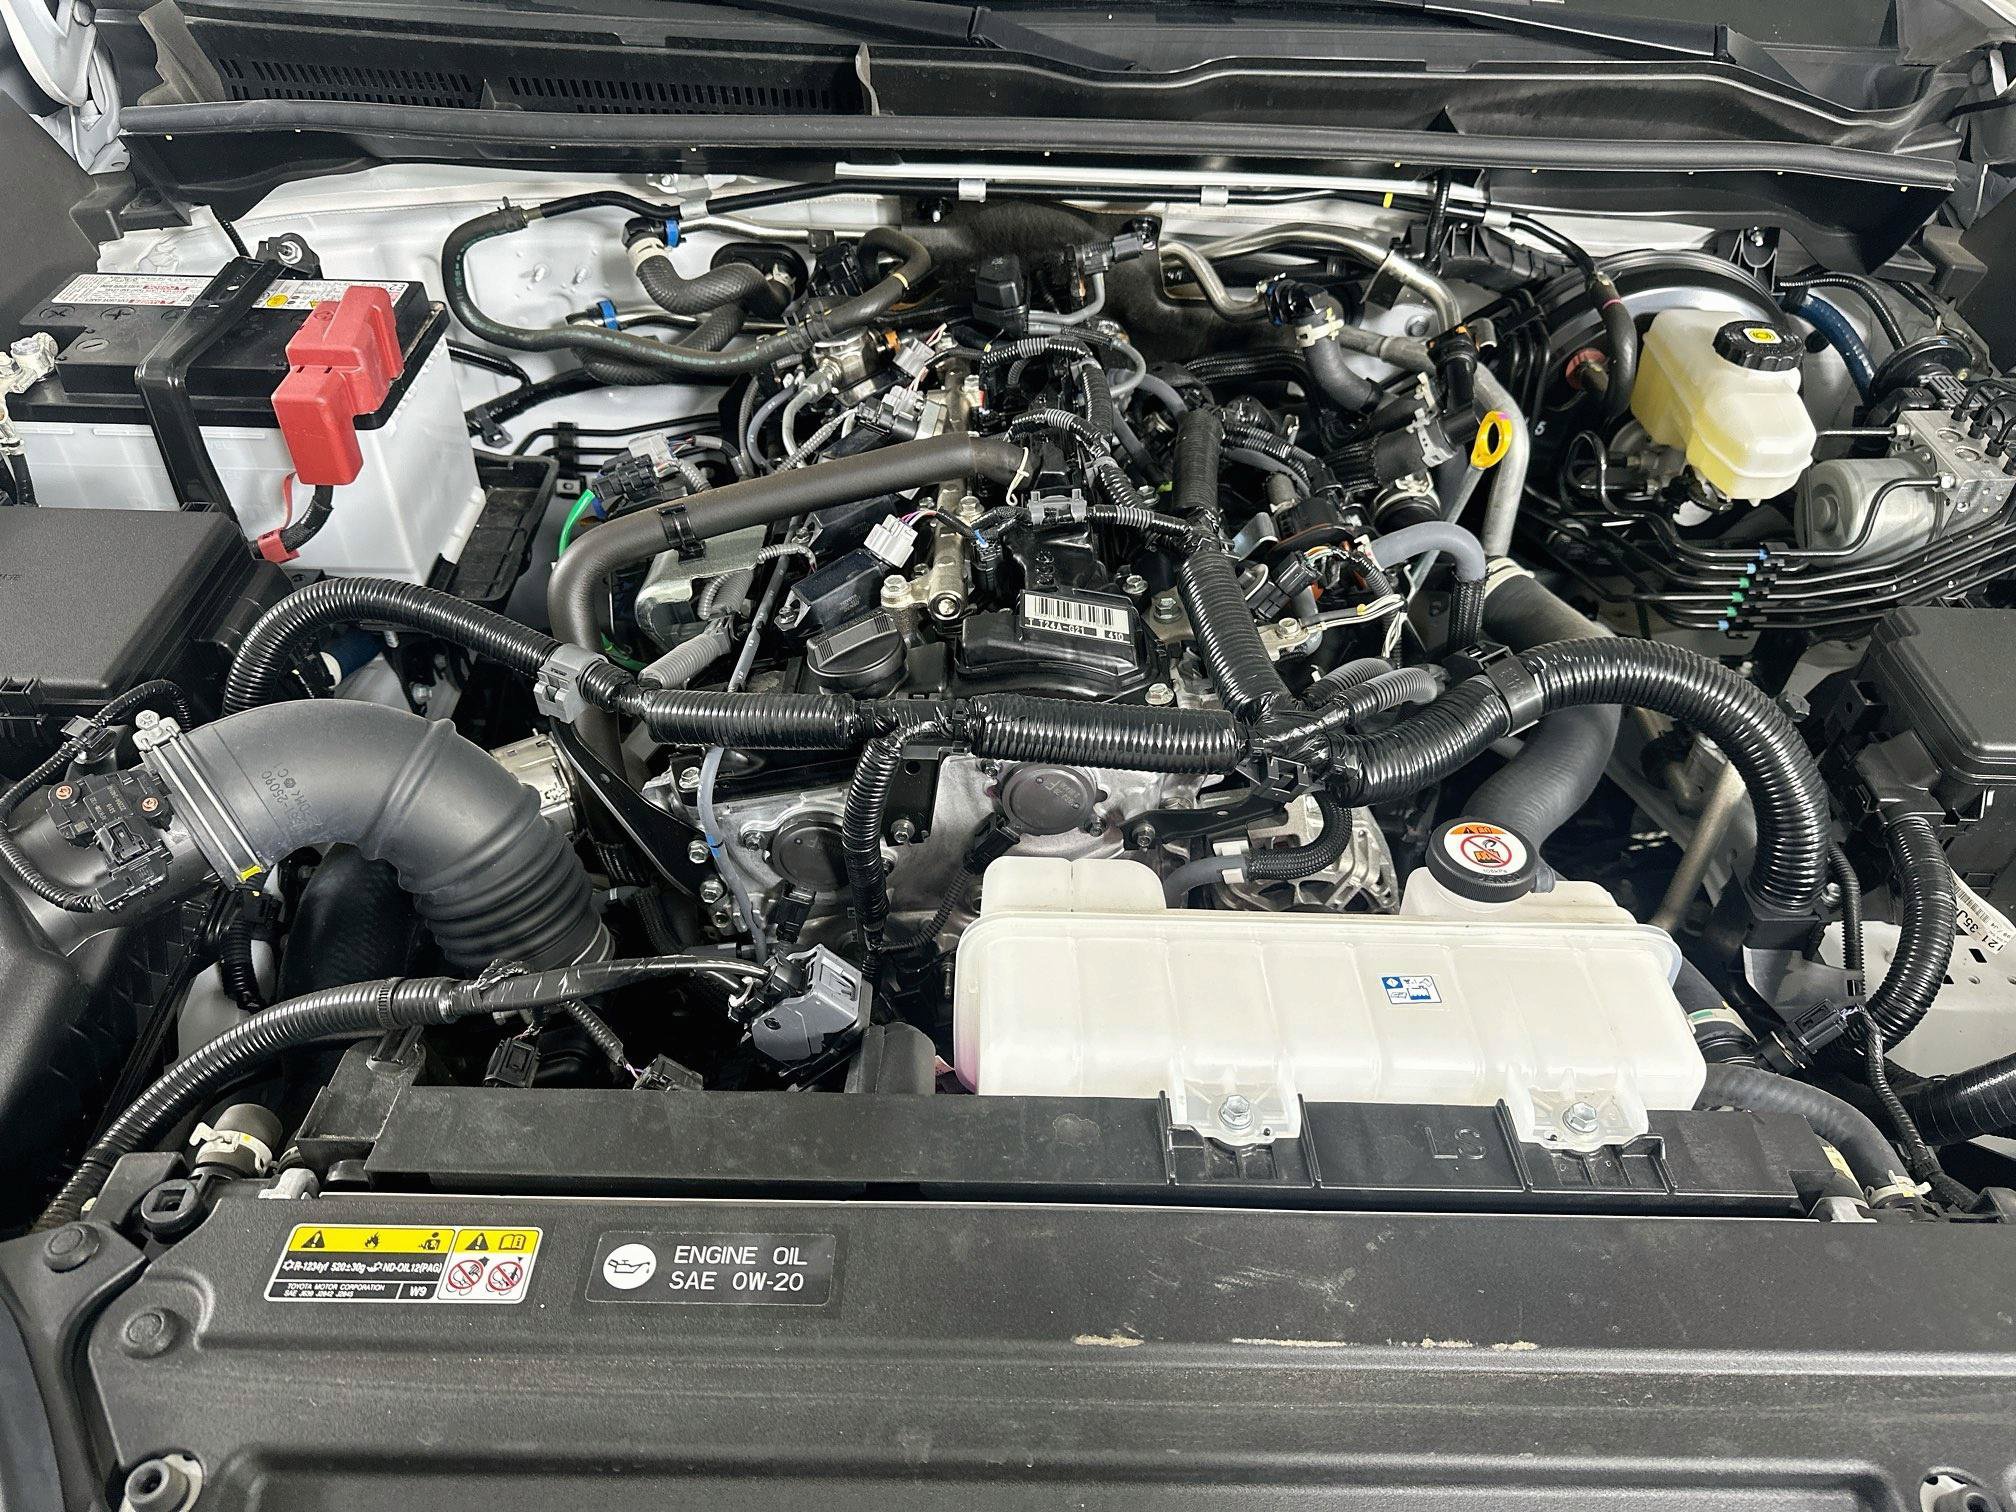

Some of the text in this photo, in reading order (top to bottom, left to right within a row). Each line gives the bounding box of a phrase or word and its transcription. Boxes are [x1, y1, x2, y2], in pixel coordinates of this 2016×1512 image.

[1038, 620, 1085, 635] T24A-G21
[1108, 631, 1125, 641] 410
[673, 1245, 808, 1266] ENGINE OIL
[293, 1260, 443, 1274] R-1234yf 520±30g ND-OIL12(PAG)
[314, 1283, 339, 1291] MOTOR
[339, 1283, 386, 1291] CORPORATION
[668, 1271, 804, 1292] SAE 0W-20
[409, 1285, 428, 1297] W9
